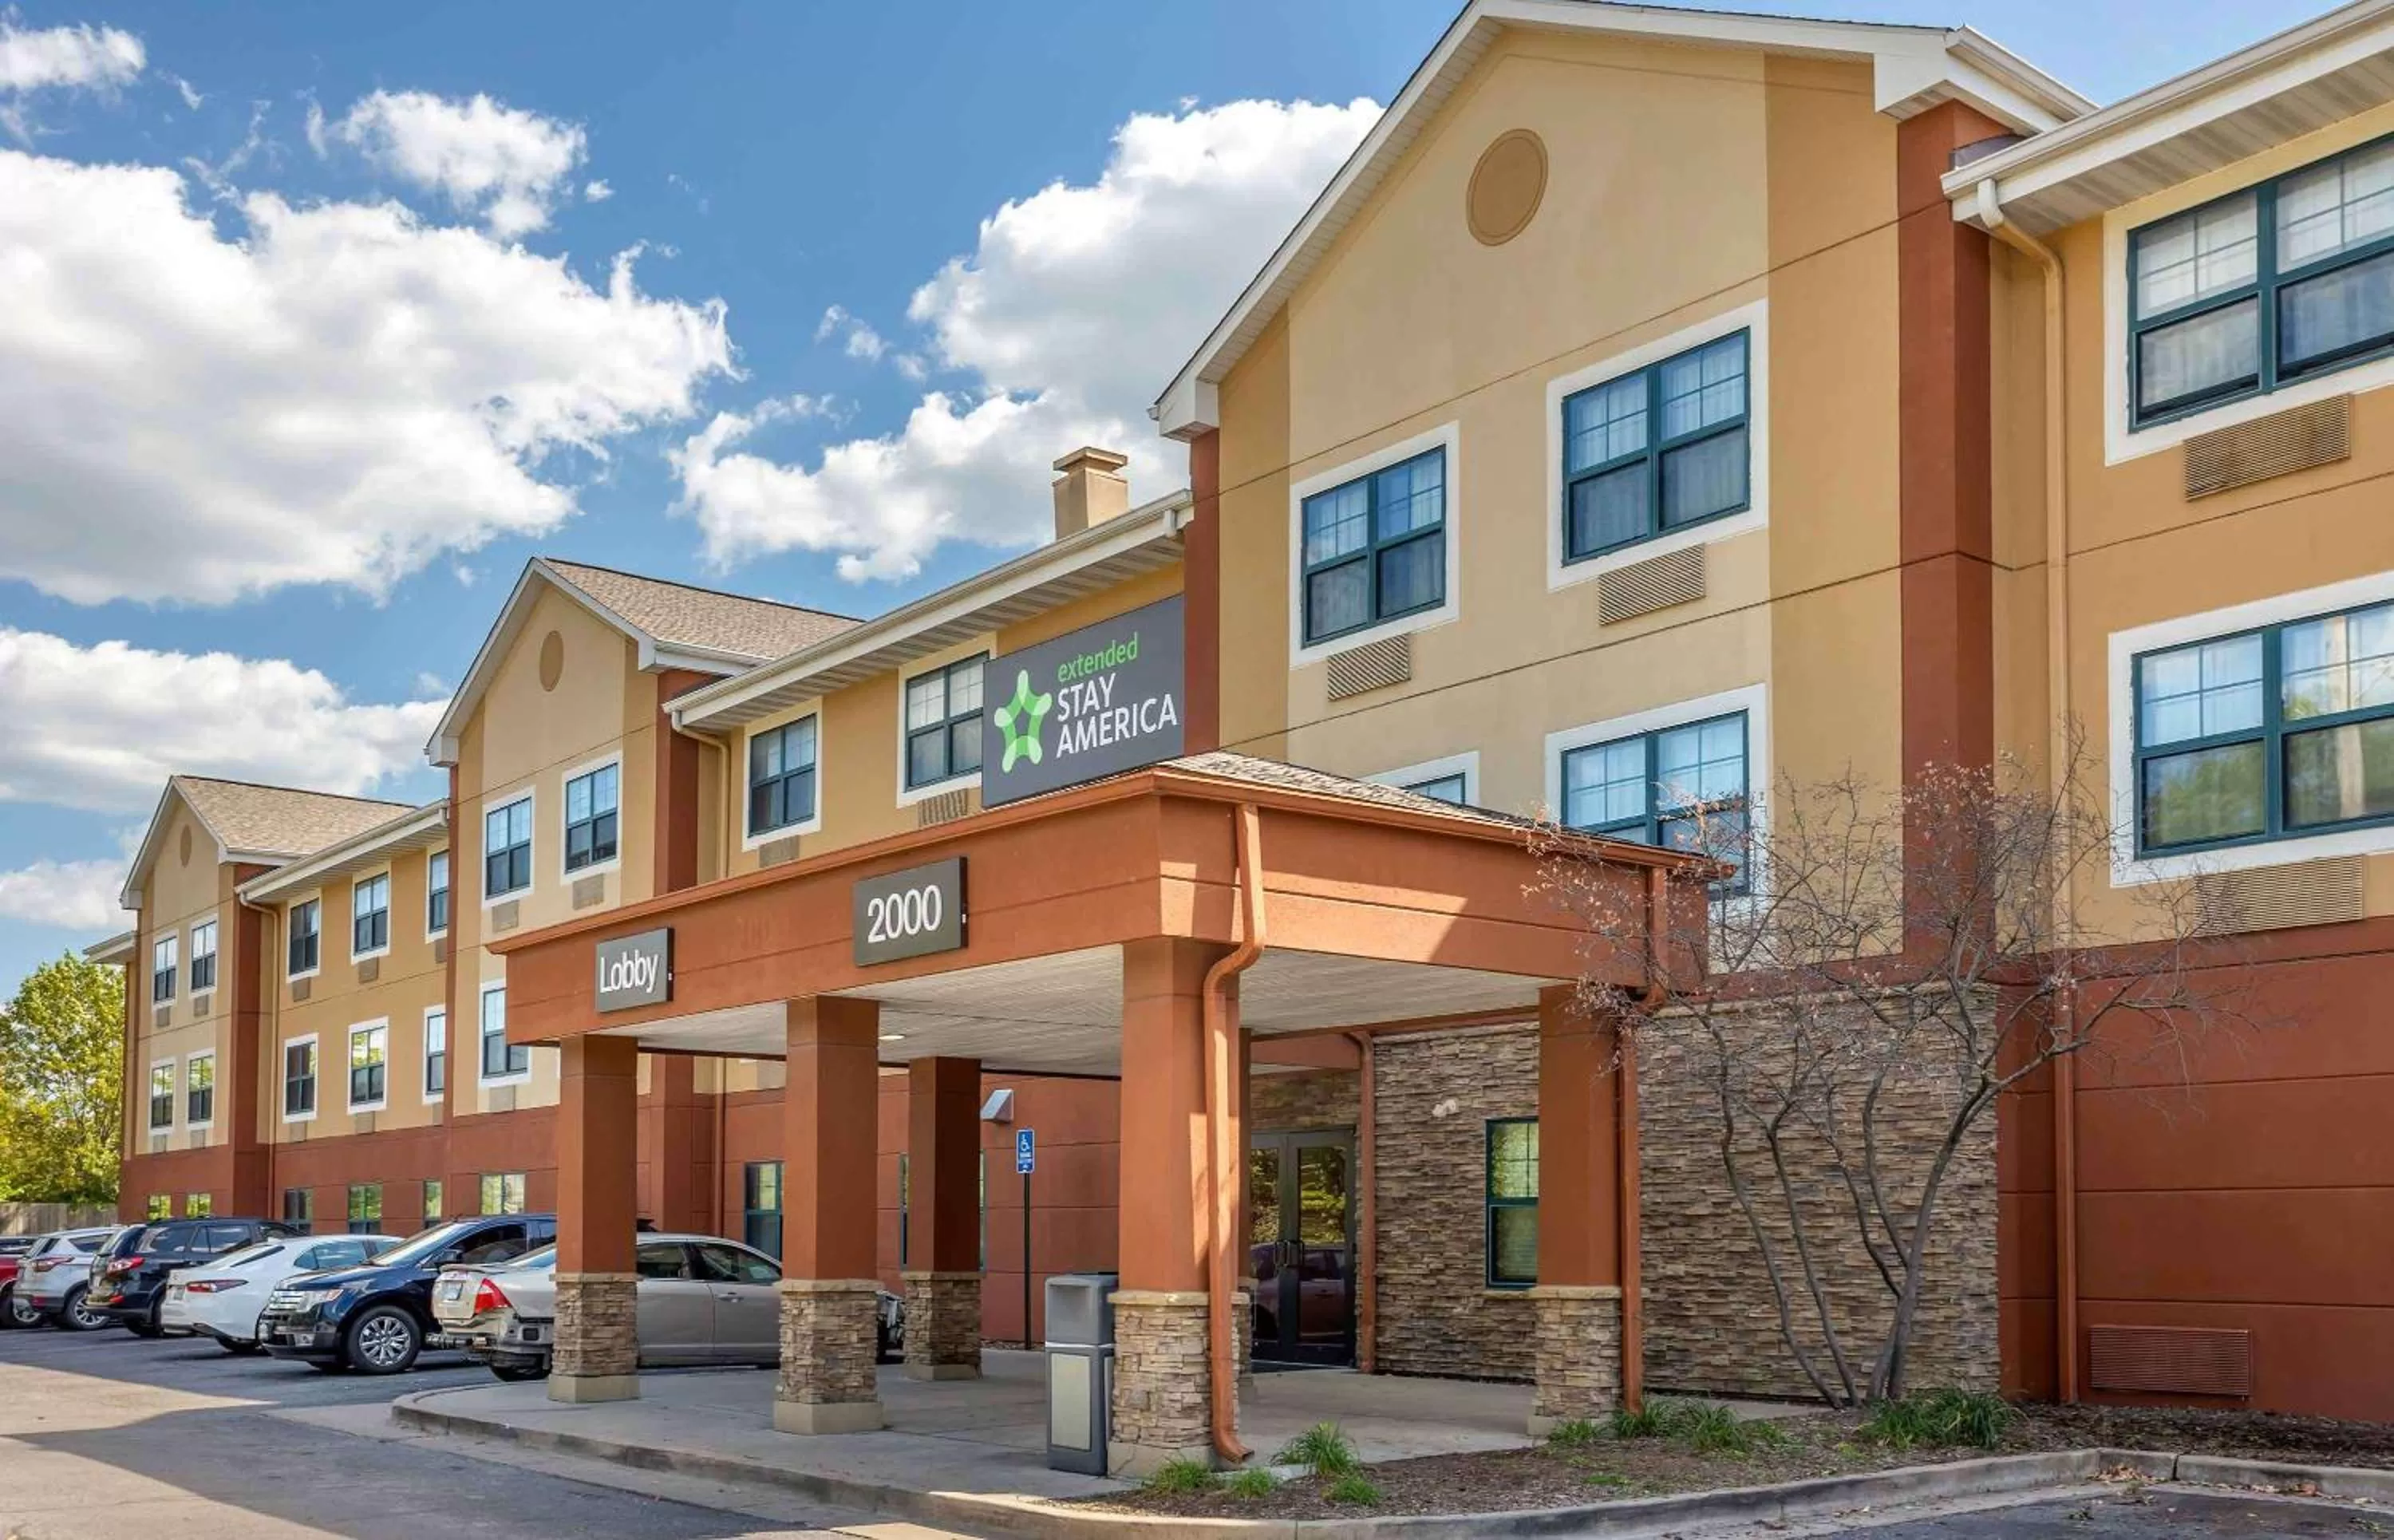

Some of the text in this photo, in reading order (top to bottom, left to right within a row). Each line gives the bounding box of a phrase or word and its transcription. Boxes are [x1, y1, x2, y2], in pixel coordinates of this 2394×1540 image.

[1057, 632, 1138, 681] extended
[1057, 673, 1116, 721] STAY
[1056, 693, 1178, 757] AMERICA
[867, 885, 942, 943] 2000
[599, 948, 658, 993] Lobby
